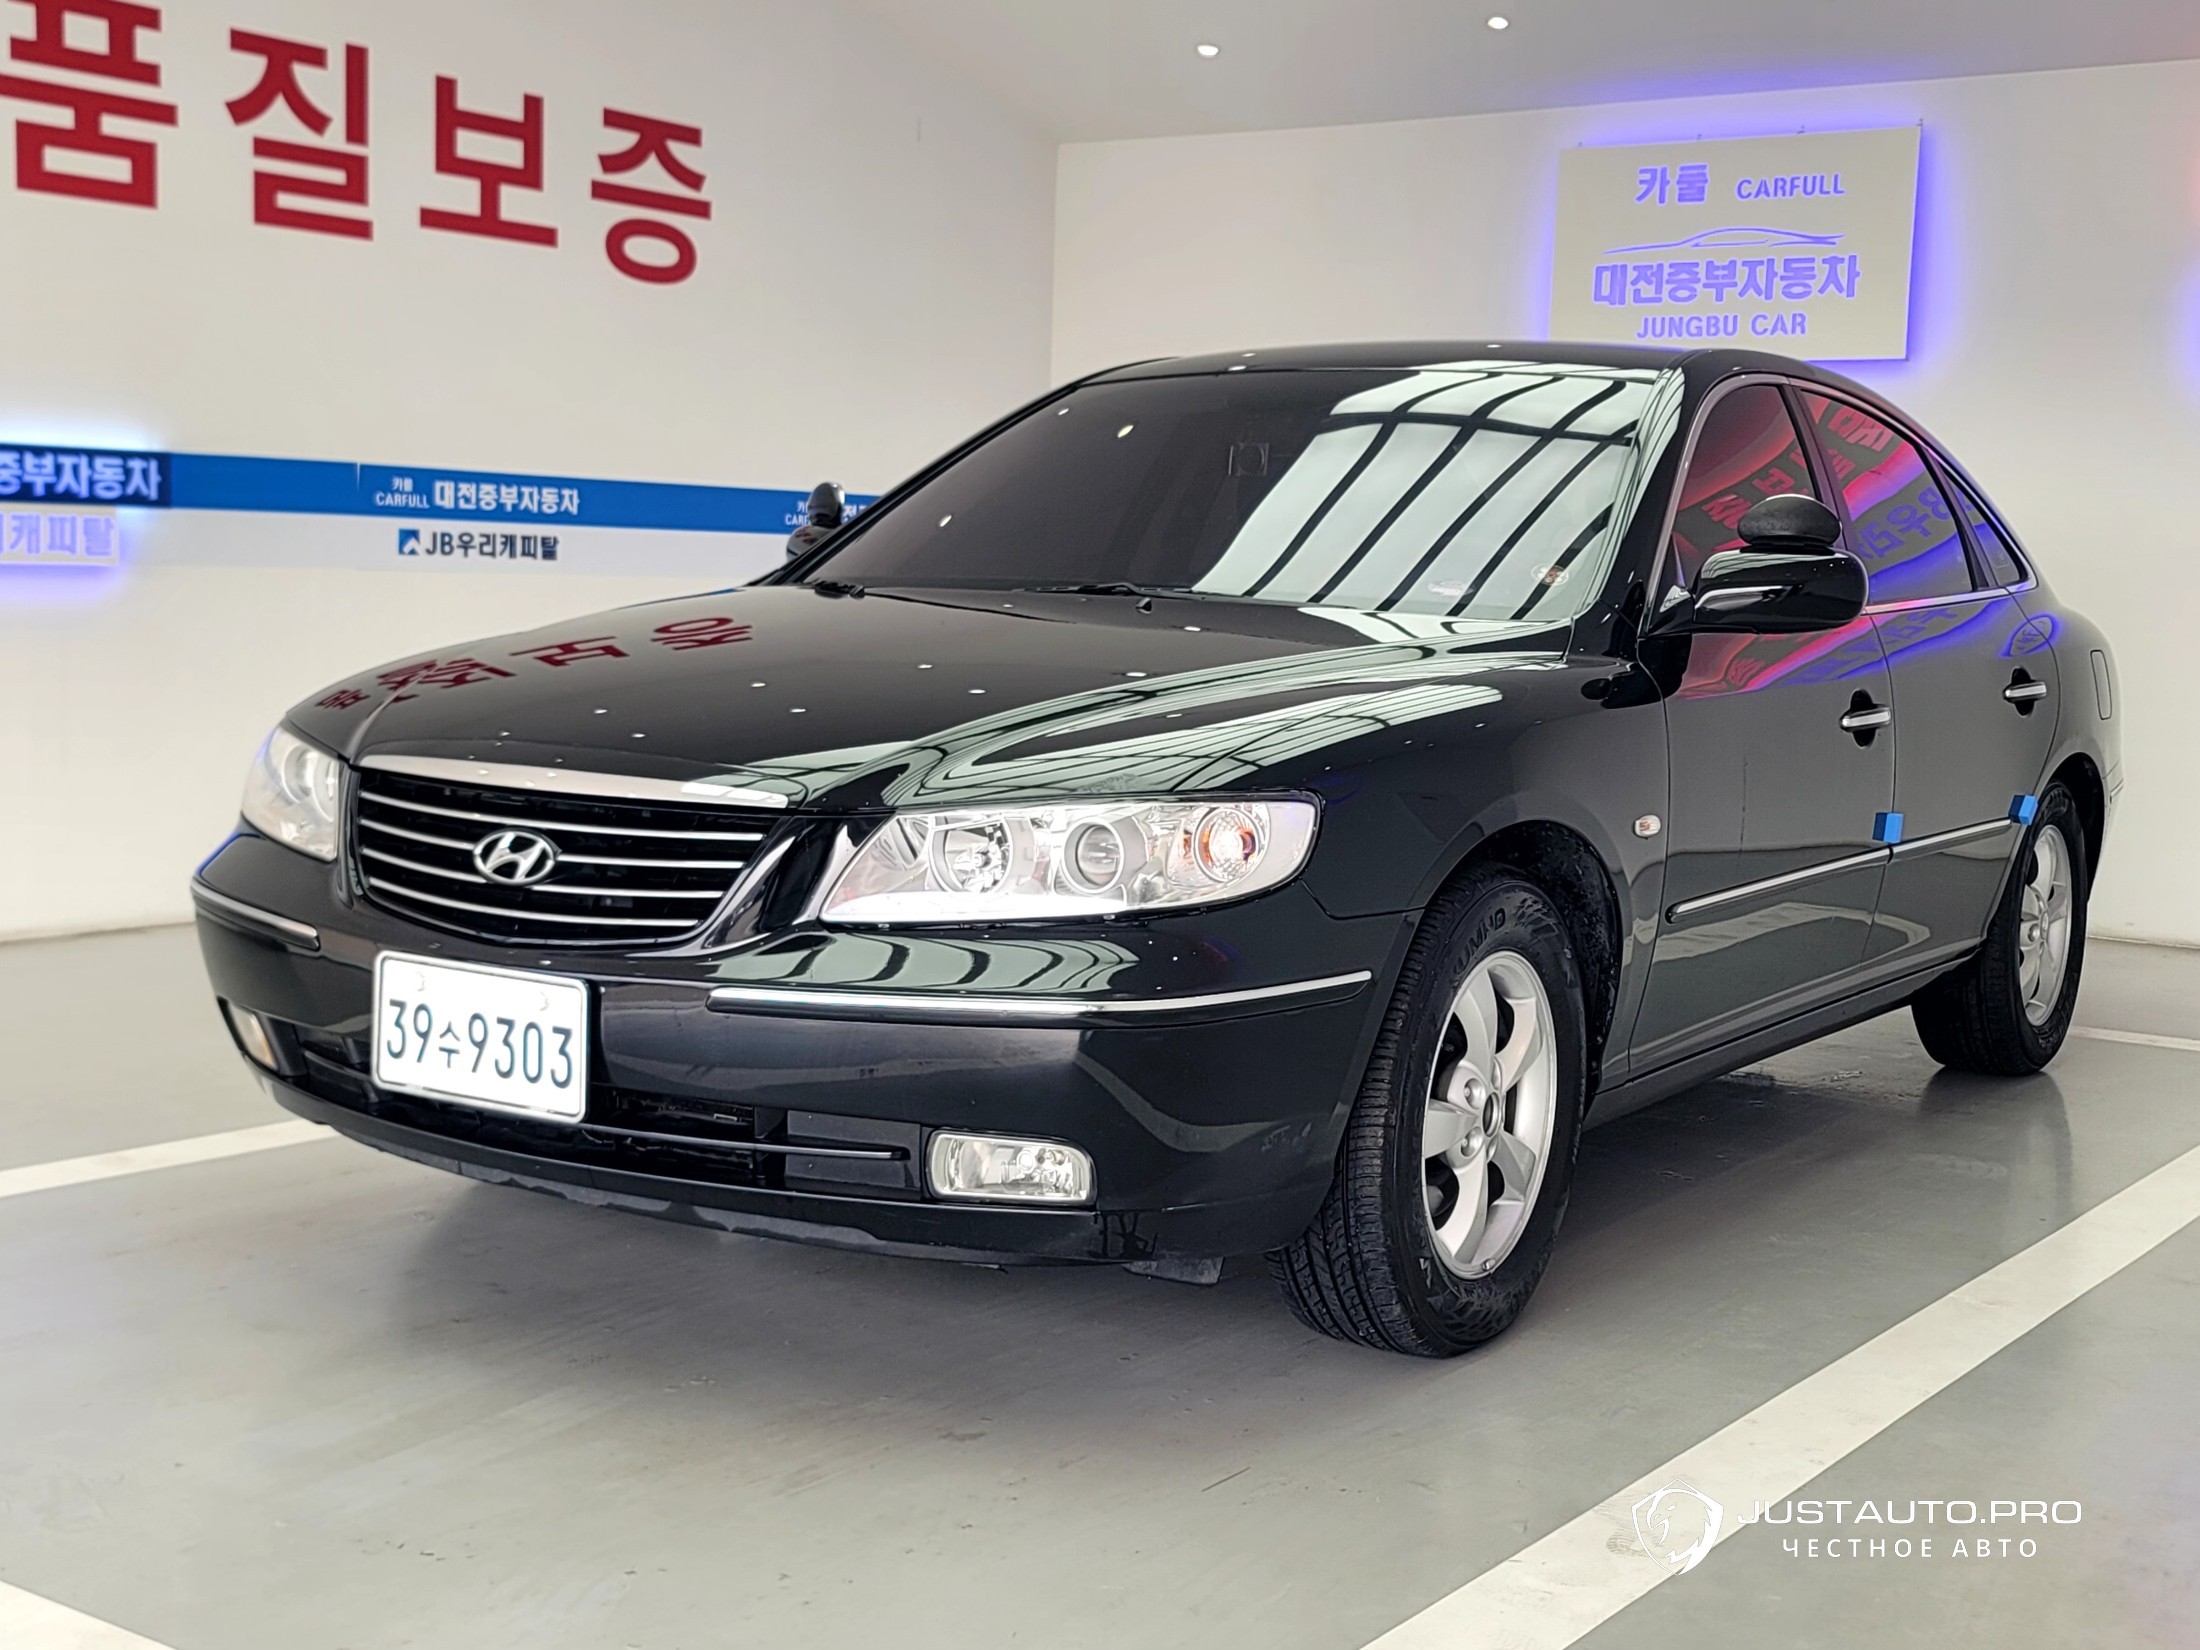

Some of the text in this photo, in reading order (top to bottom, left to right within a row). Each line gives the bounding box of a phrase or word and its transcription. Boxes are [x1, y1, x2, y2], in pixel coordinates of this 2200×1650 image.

[0, 0, 712, 285] 품질보증
[1736, 173, 1845, 200] CARFULL
[1593, 254, 1861, 306] 대전중부자동차
[1636, 312, 1808, 340] JUNGBU CAR
[375, 491, 431, 510] CARFULL
[433, 479, 580, 516] 대전중부자동차
[424, 531, 560, 562] JB우리캐피탈
[386, 998, 574, 1089] 39수9303
